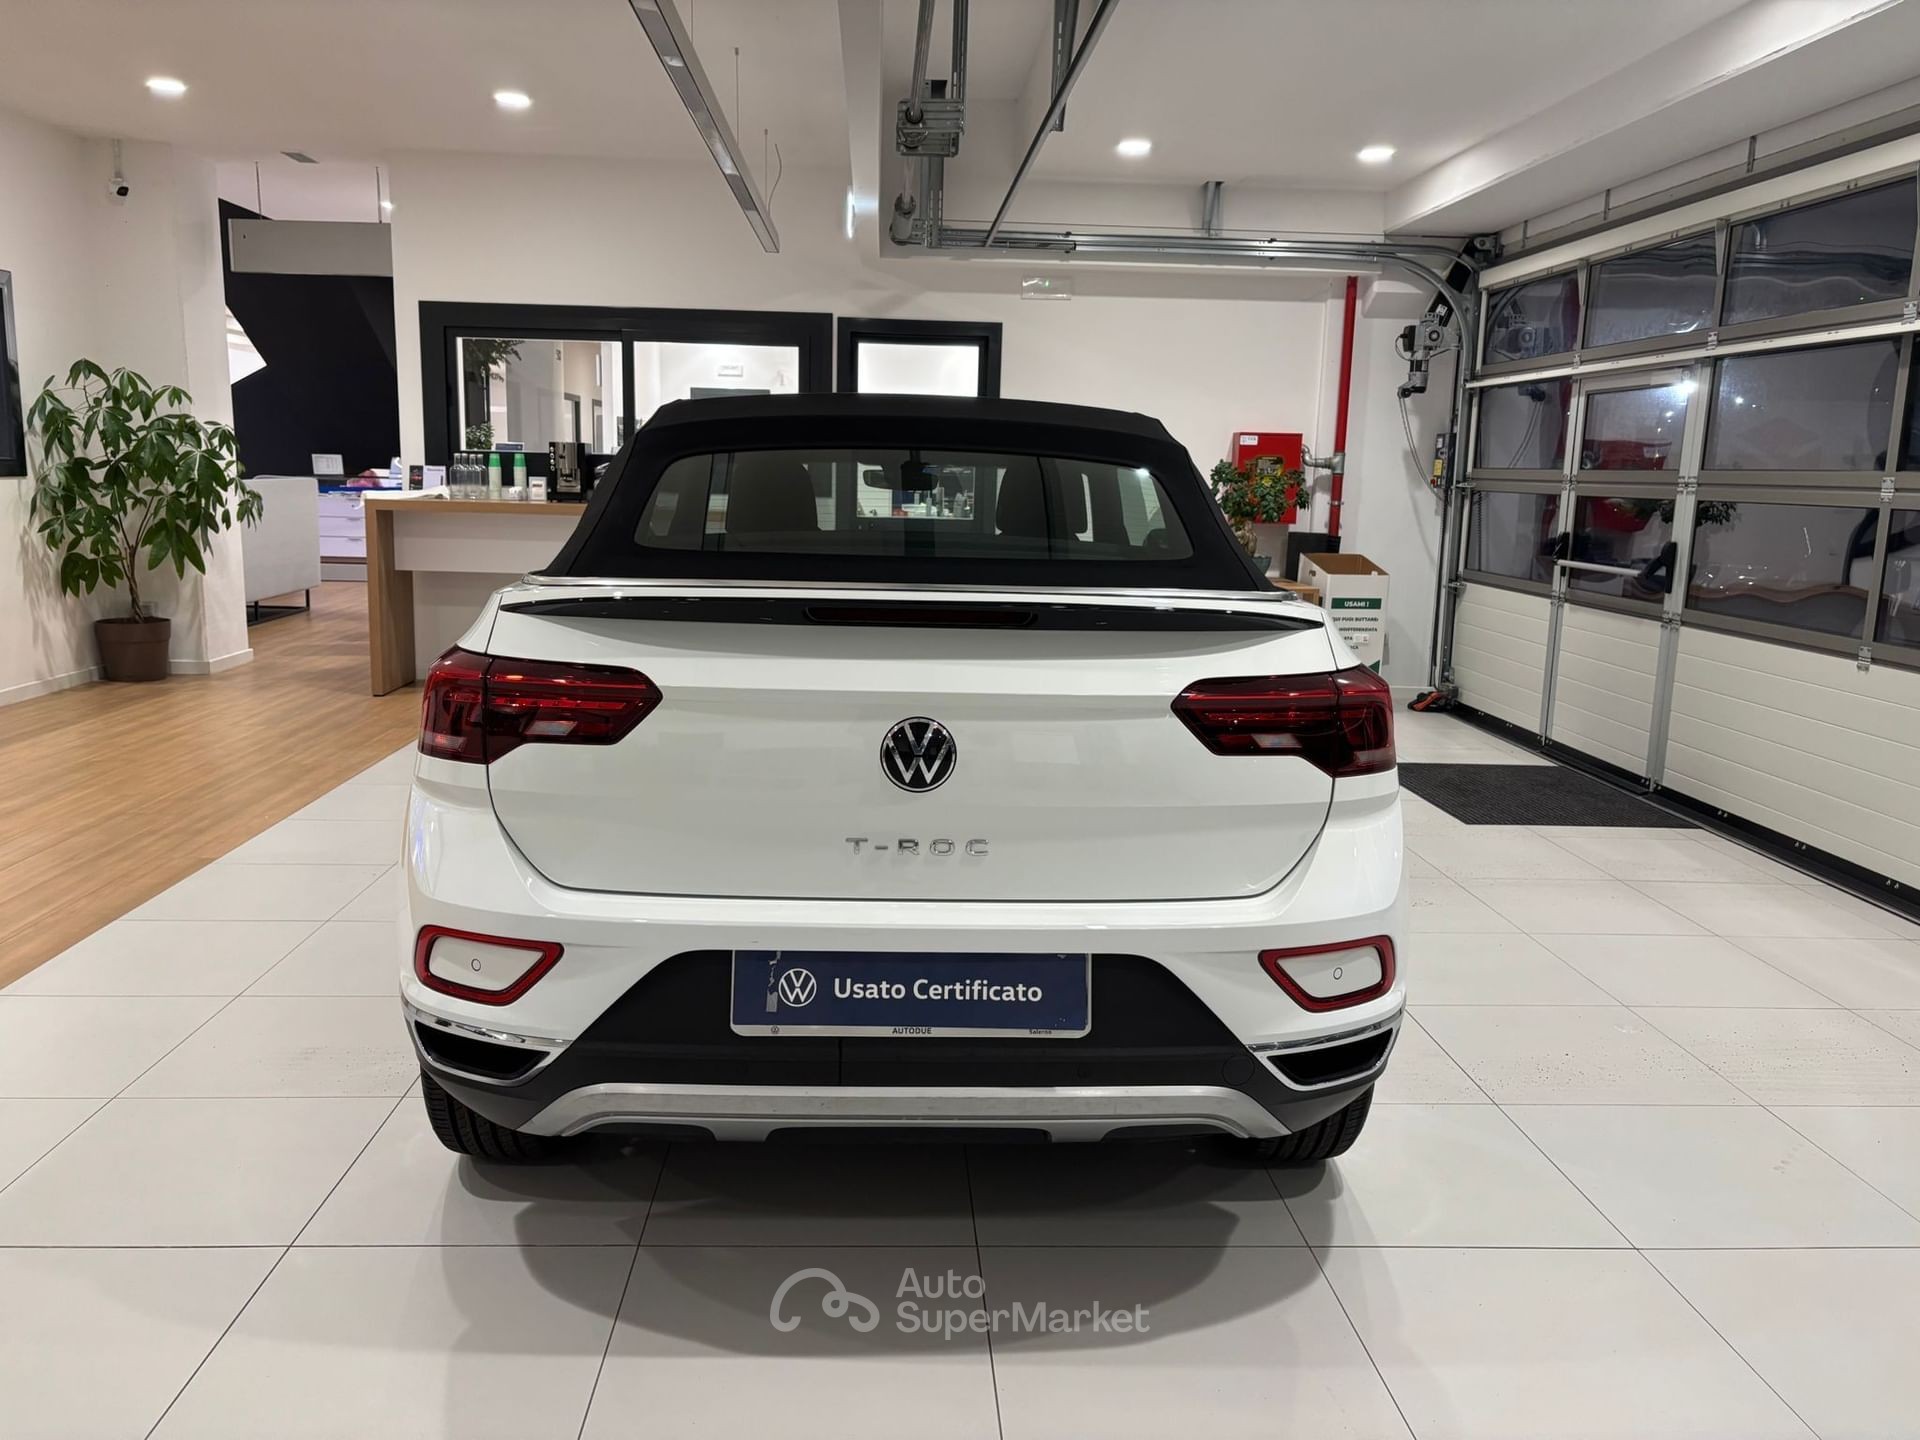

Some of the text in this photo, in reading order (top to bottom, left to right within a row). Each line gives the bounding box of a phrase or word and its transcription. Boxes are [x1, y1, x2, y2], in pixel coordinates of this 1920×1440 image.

[845, 837, 989, 857] T-ROC
[834, 978, 906, 999] Usato
[913, 979, 1043, 1002] Certificato
[892, 1027, 933, 1035] AUTODUE
